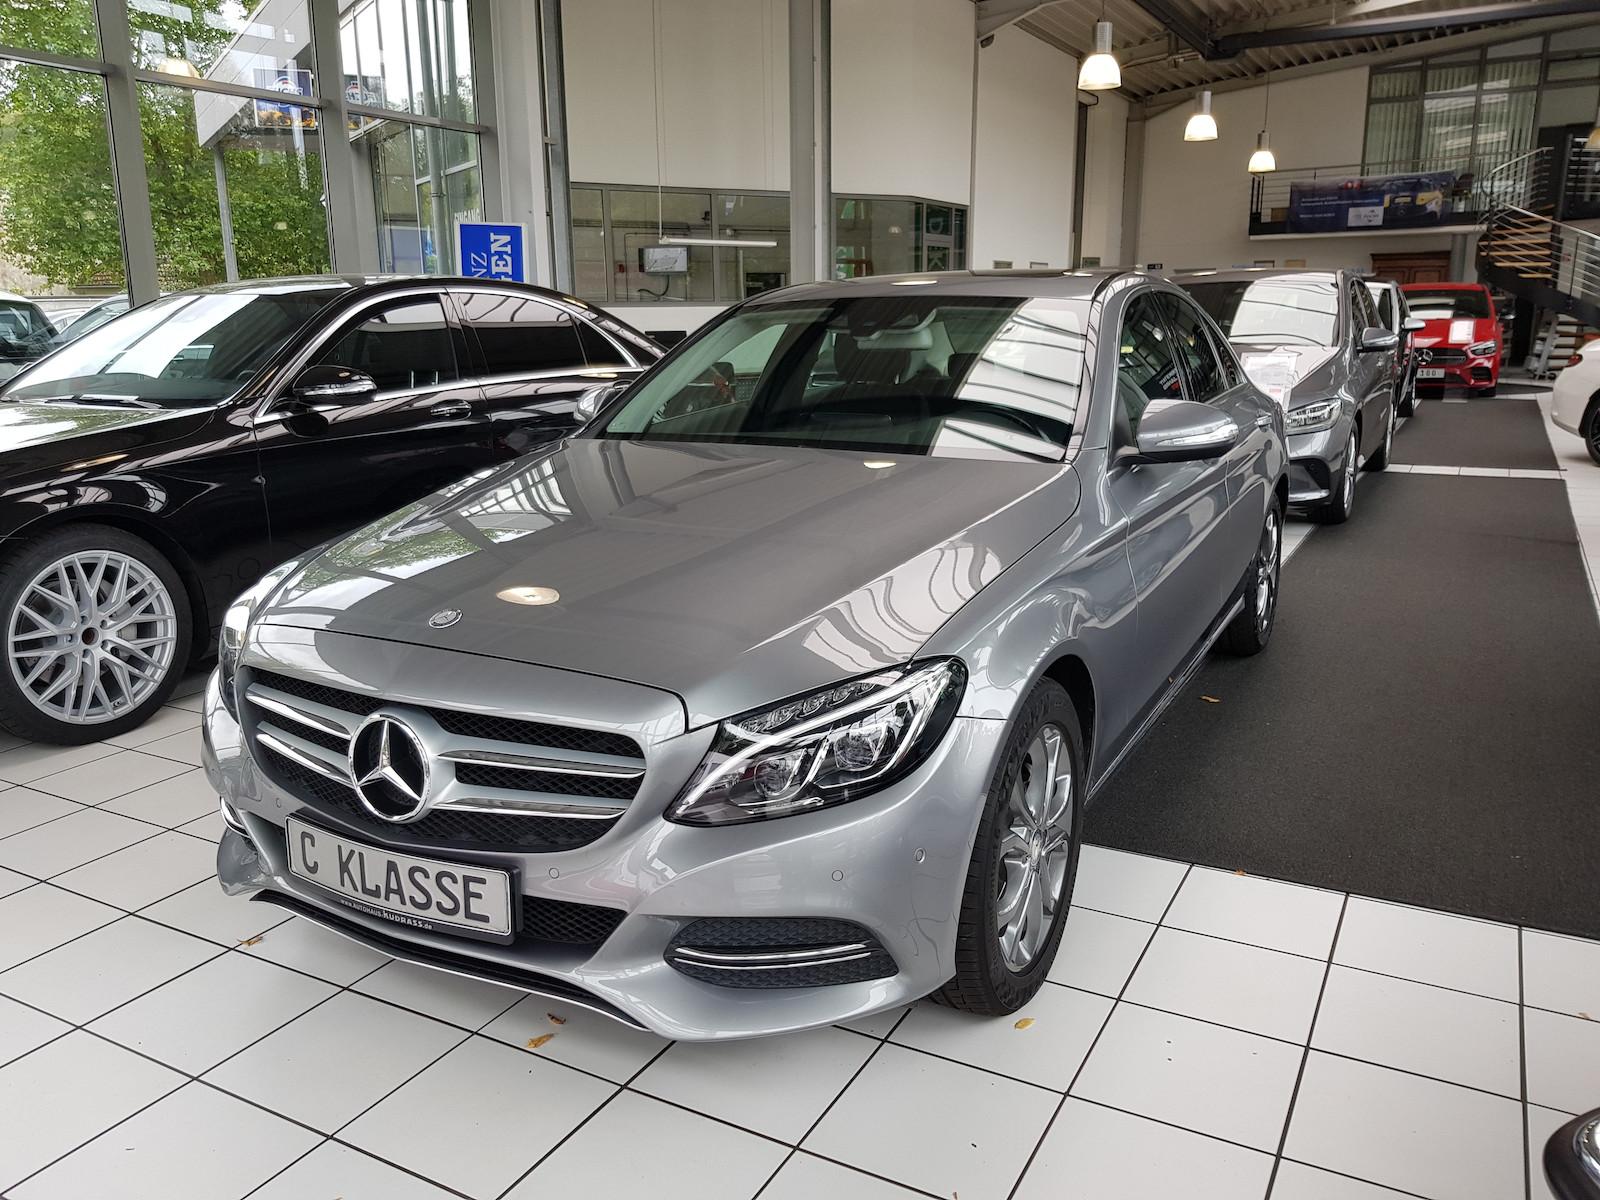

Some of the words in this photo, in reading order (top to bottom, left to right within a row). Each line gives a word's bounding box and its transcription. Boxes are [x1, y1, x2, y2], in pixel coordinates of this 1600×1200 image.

[489, 232, 513, 281] EN
[299, 831, 319, 875] C
[337, 844, 491, 924] KLASSE
